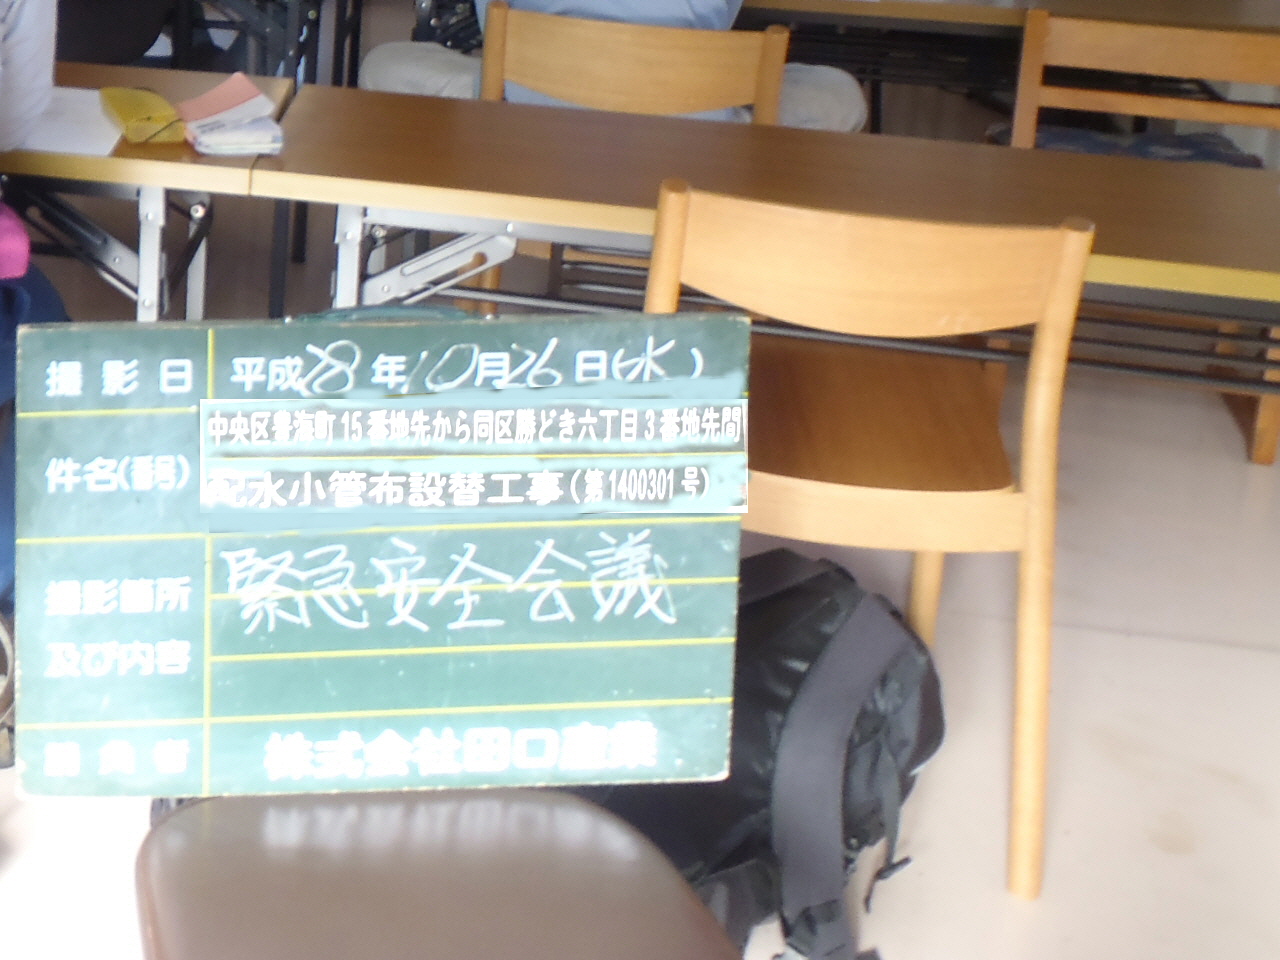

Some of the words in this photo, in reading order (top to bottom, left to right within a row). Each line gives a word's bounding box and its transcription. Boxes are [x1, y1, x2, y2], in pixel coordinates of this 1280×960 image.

[220, 528, 678, 635] 緊急安全会議
